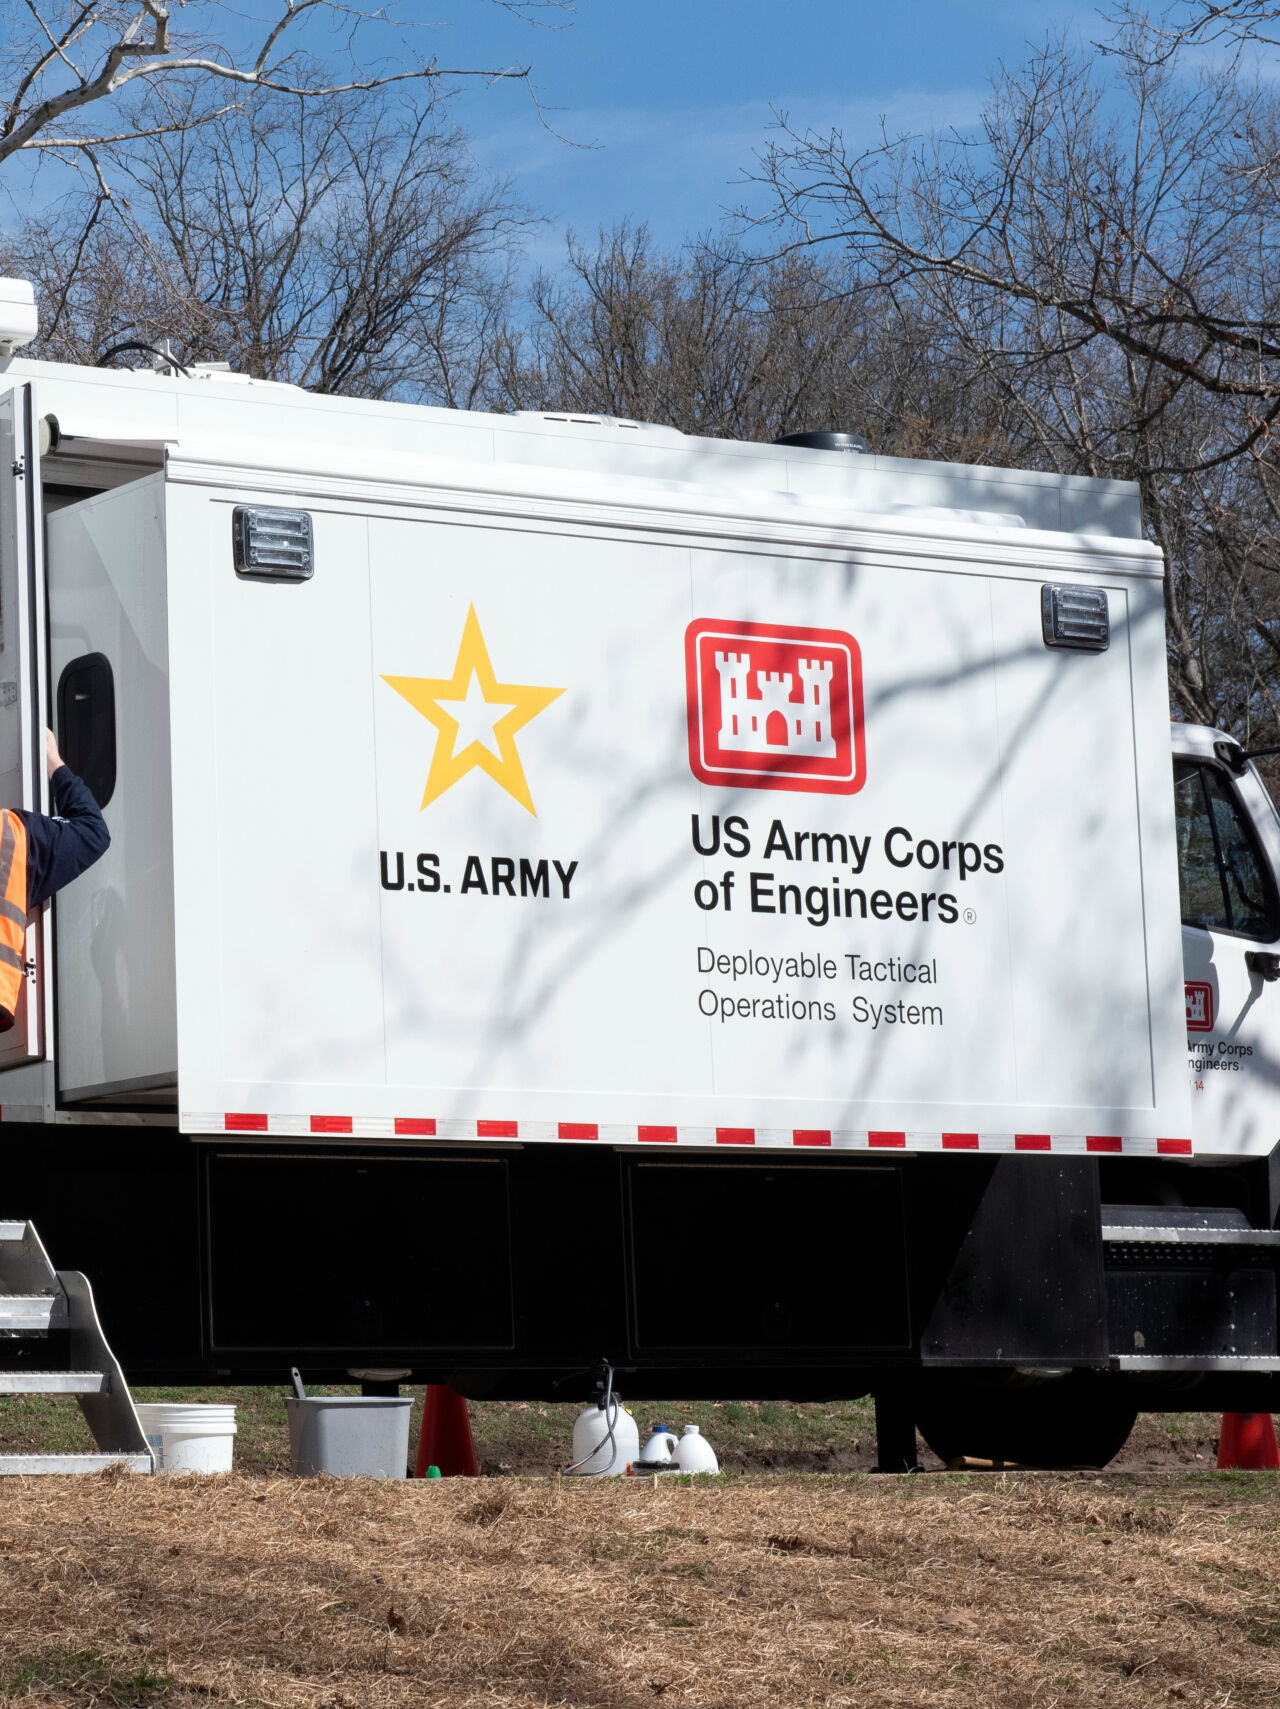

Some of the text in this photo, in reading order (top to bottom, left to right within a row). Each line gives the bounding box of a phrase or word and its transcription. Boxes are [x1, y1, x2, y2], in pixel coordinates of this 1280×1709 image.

[691, 814, 1005, 881] US Army Corps
[380, 850, 579, 899] U.S. ARMY
[694, 870, 735, 911] of
[697, 946, 937, 984] Deployable Tactical
[698, 989, 943, 1030] Operations System
[1217, 1041, 1253, 1058] Corps
[1194, 1080, 1204, 1091] 14
